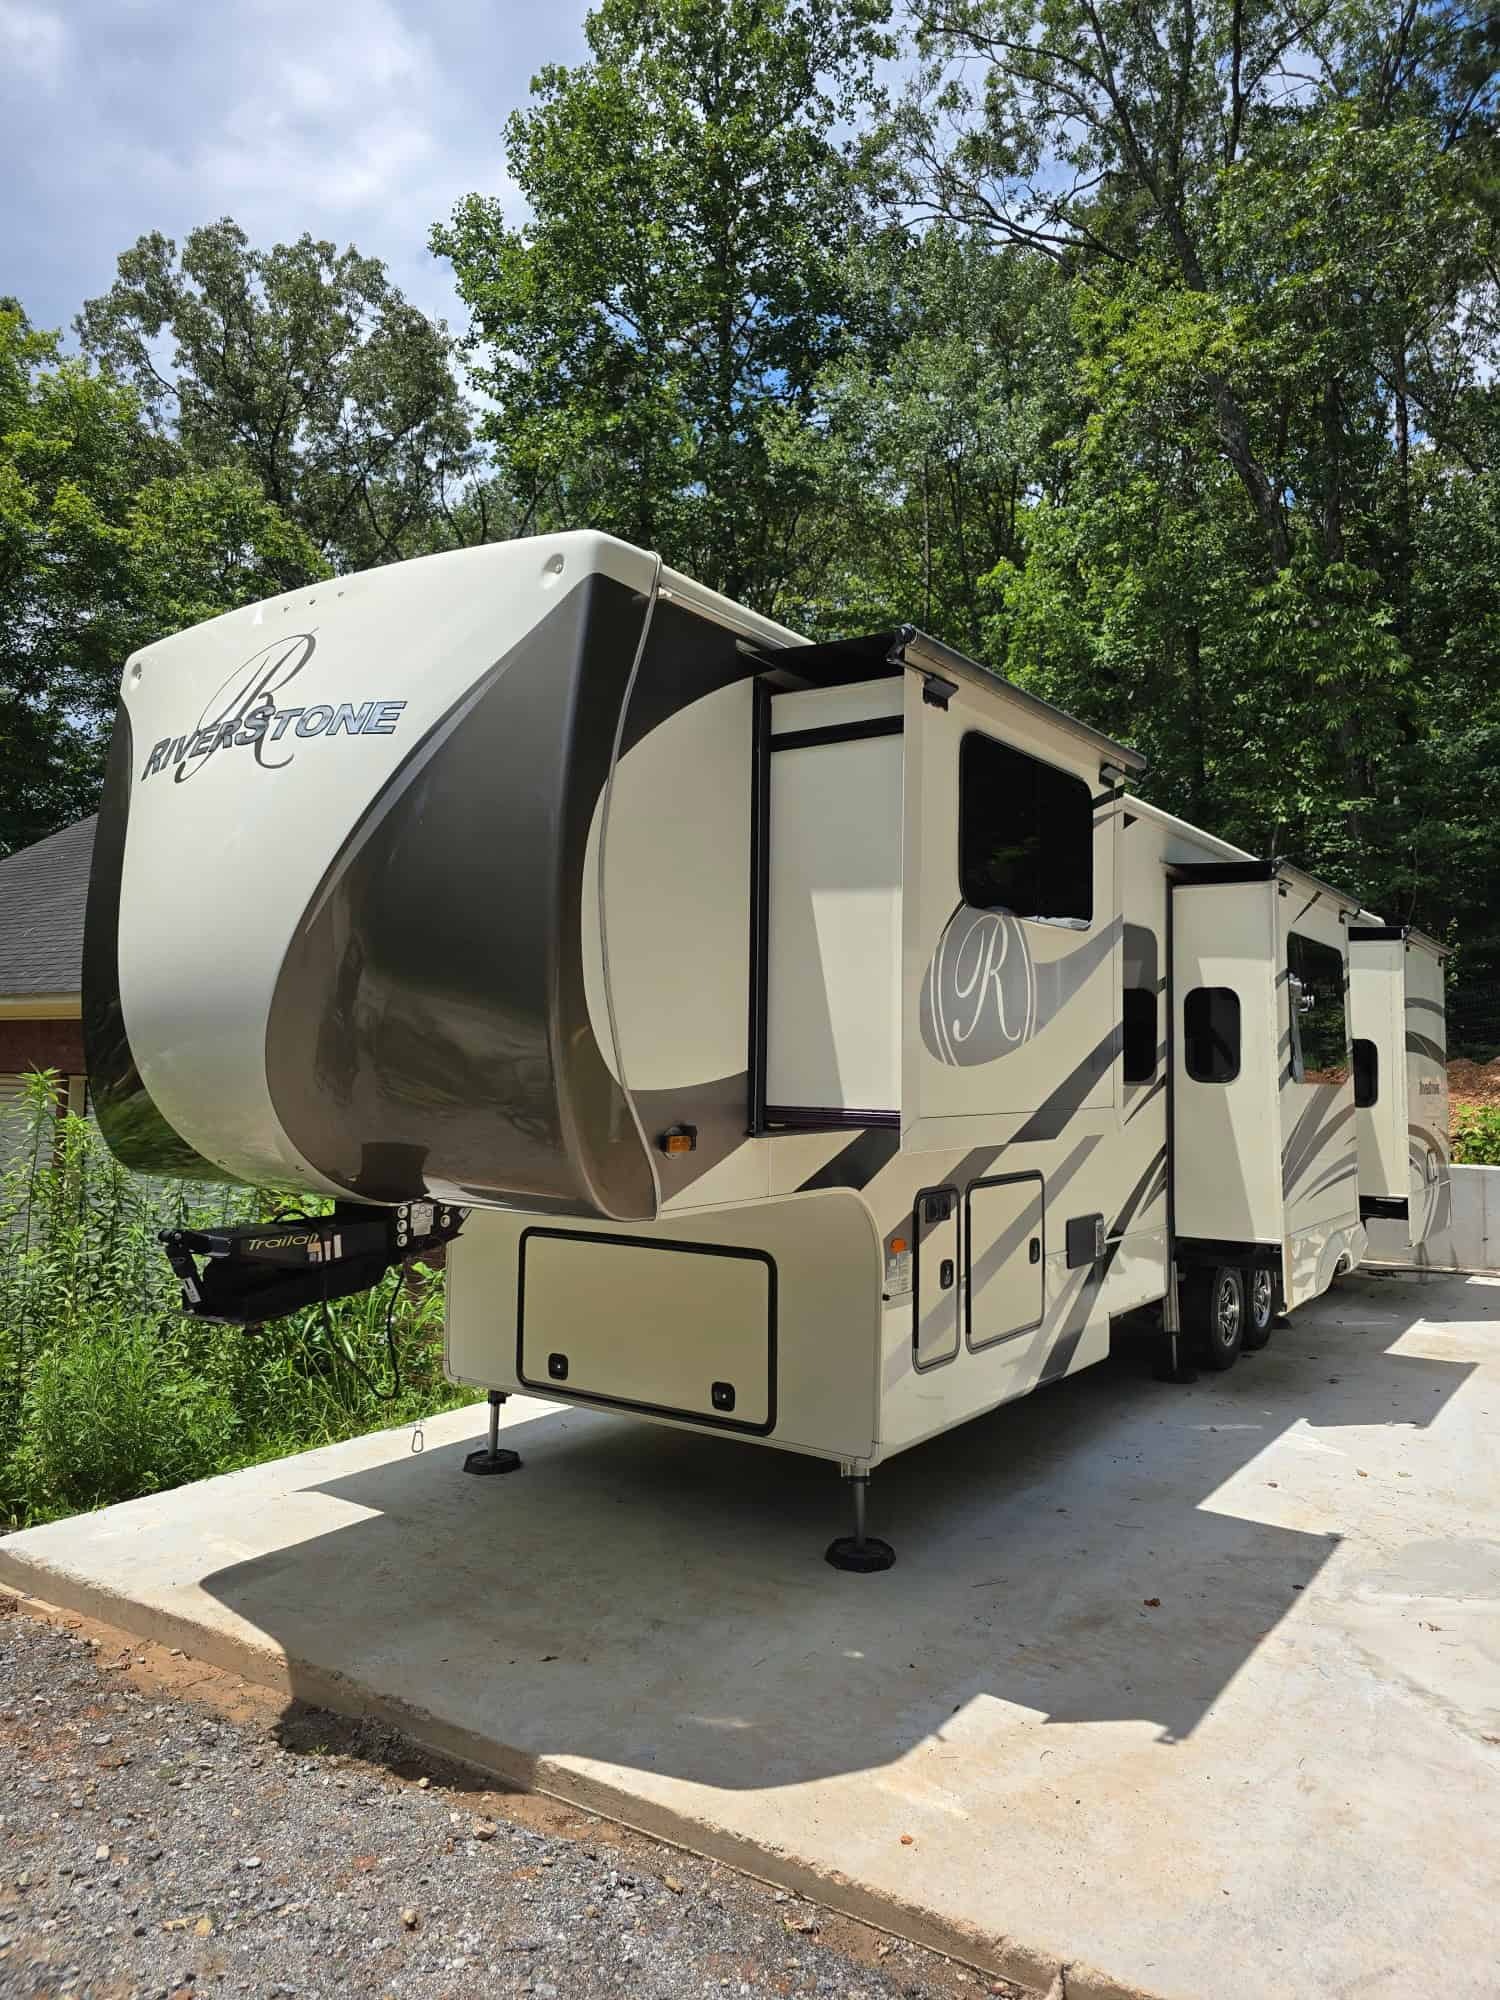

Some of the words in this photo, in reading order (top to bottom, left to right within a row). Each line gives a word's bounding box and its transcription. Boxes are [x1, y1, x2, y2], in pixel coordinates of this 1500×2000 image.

[141, 701, 407, 781] RIVERSTONE
[174, 627, 318, 783] R
[952, 913, 1022, 1042] R
